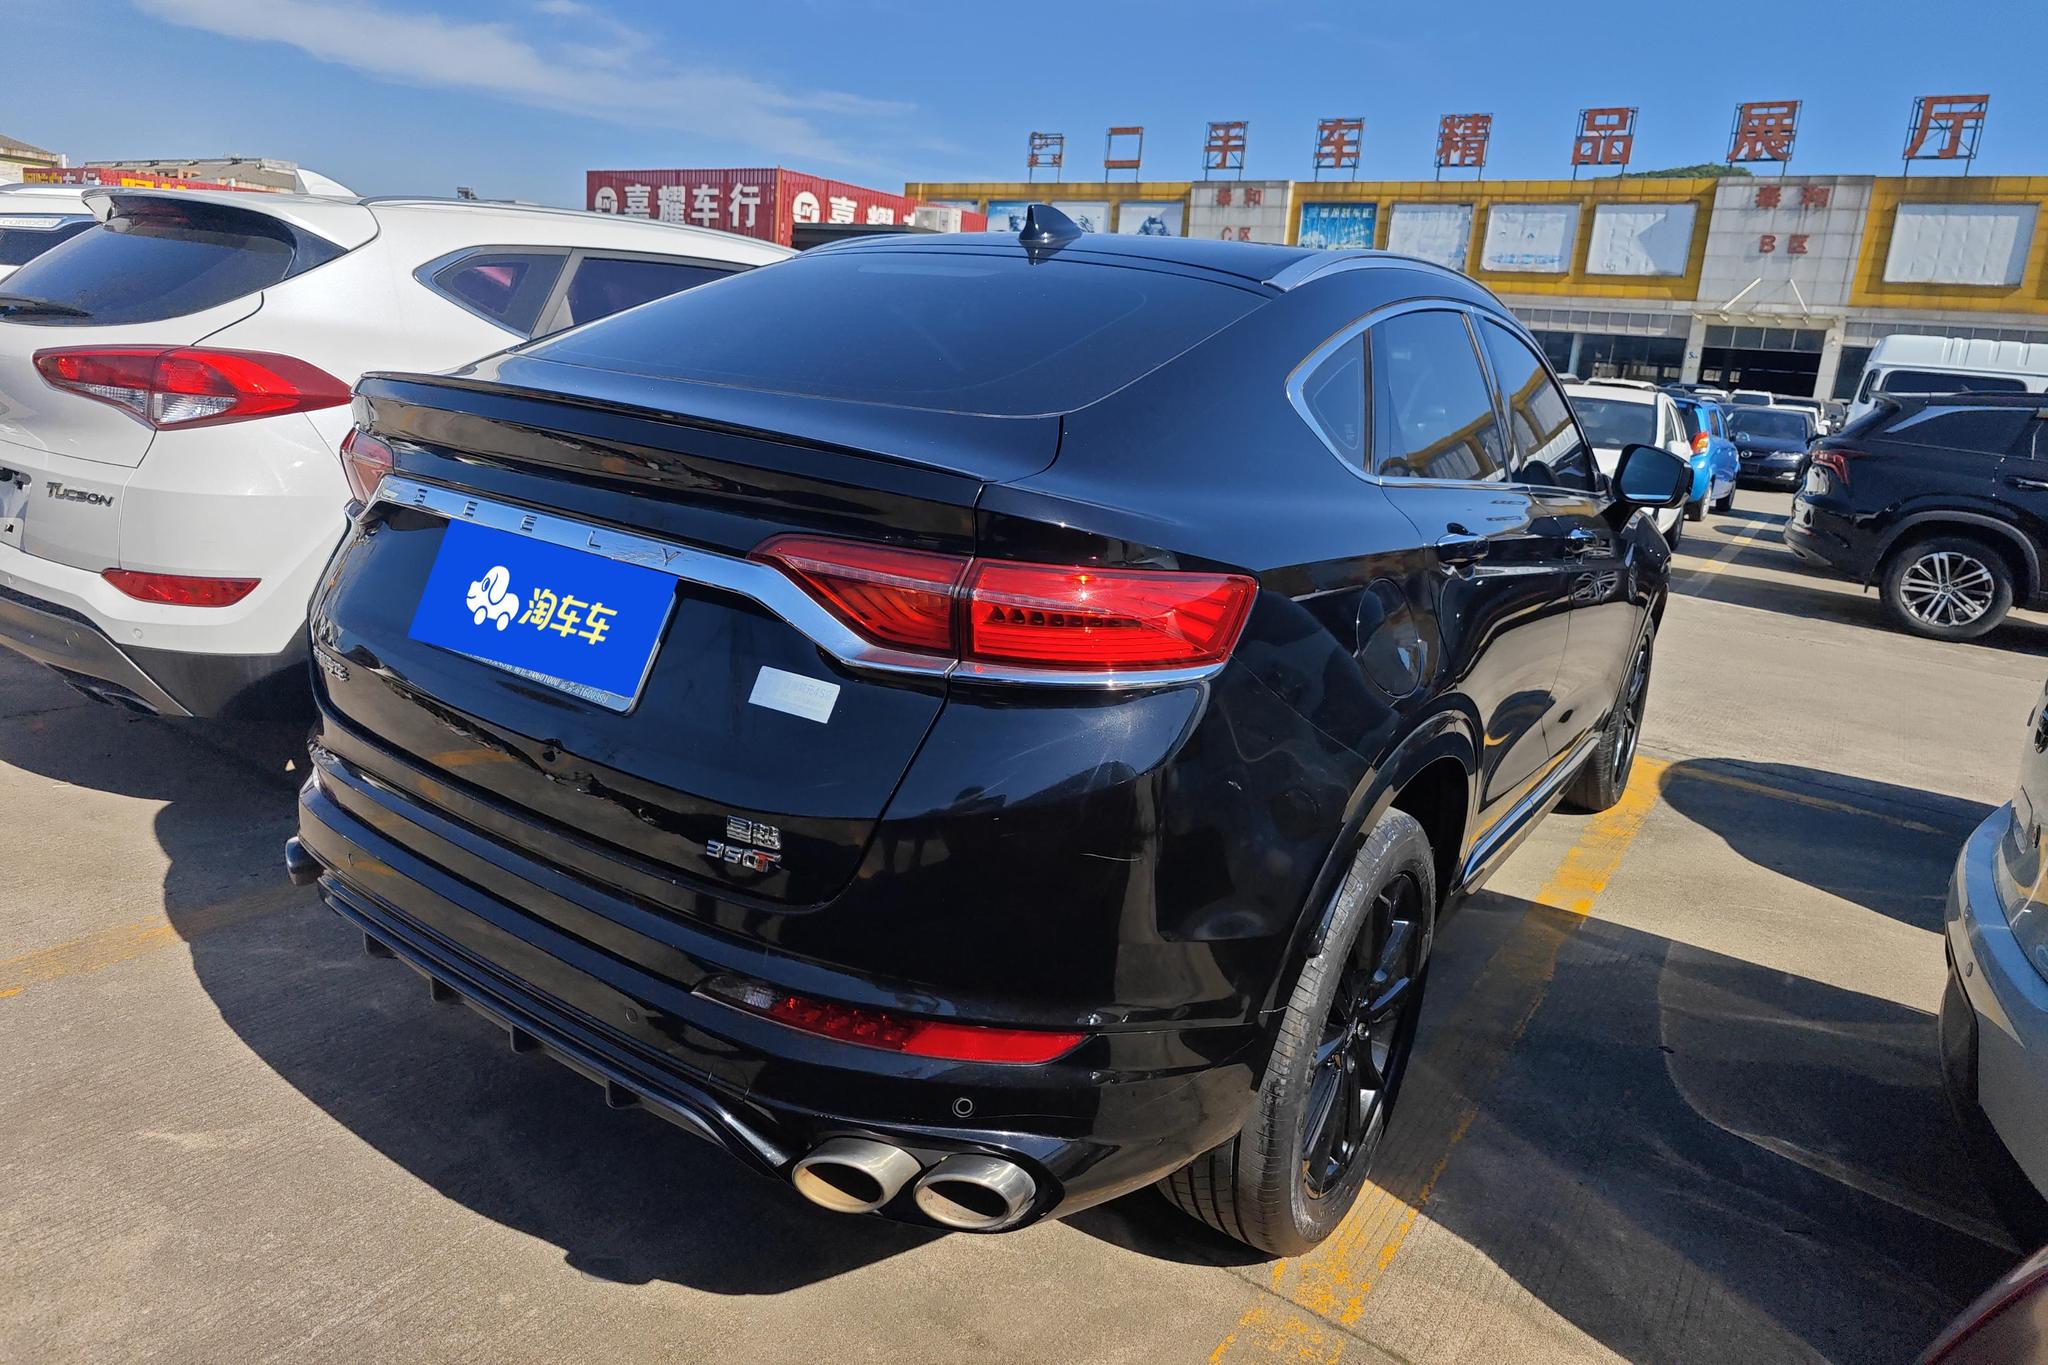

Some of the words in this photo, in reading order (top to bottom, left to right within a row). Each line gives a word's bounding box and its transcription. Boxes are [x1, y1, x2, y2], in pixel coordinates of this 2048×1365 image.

[1027, 94, 1990, 169] 二手车精品展厅
[414, 488, 681, 566] GEELY
